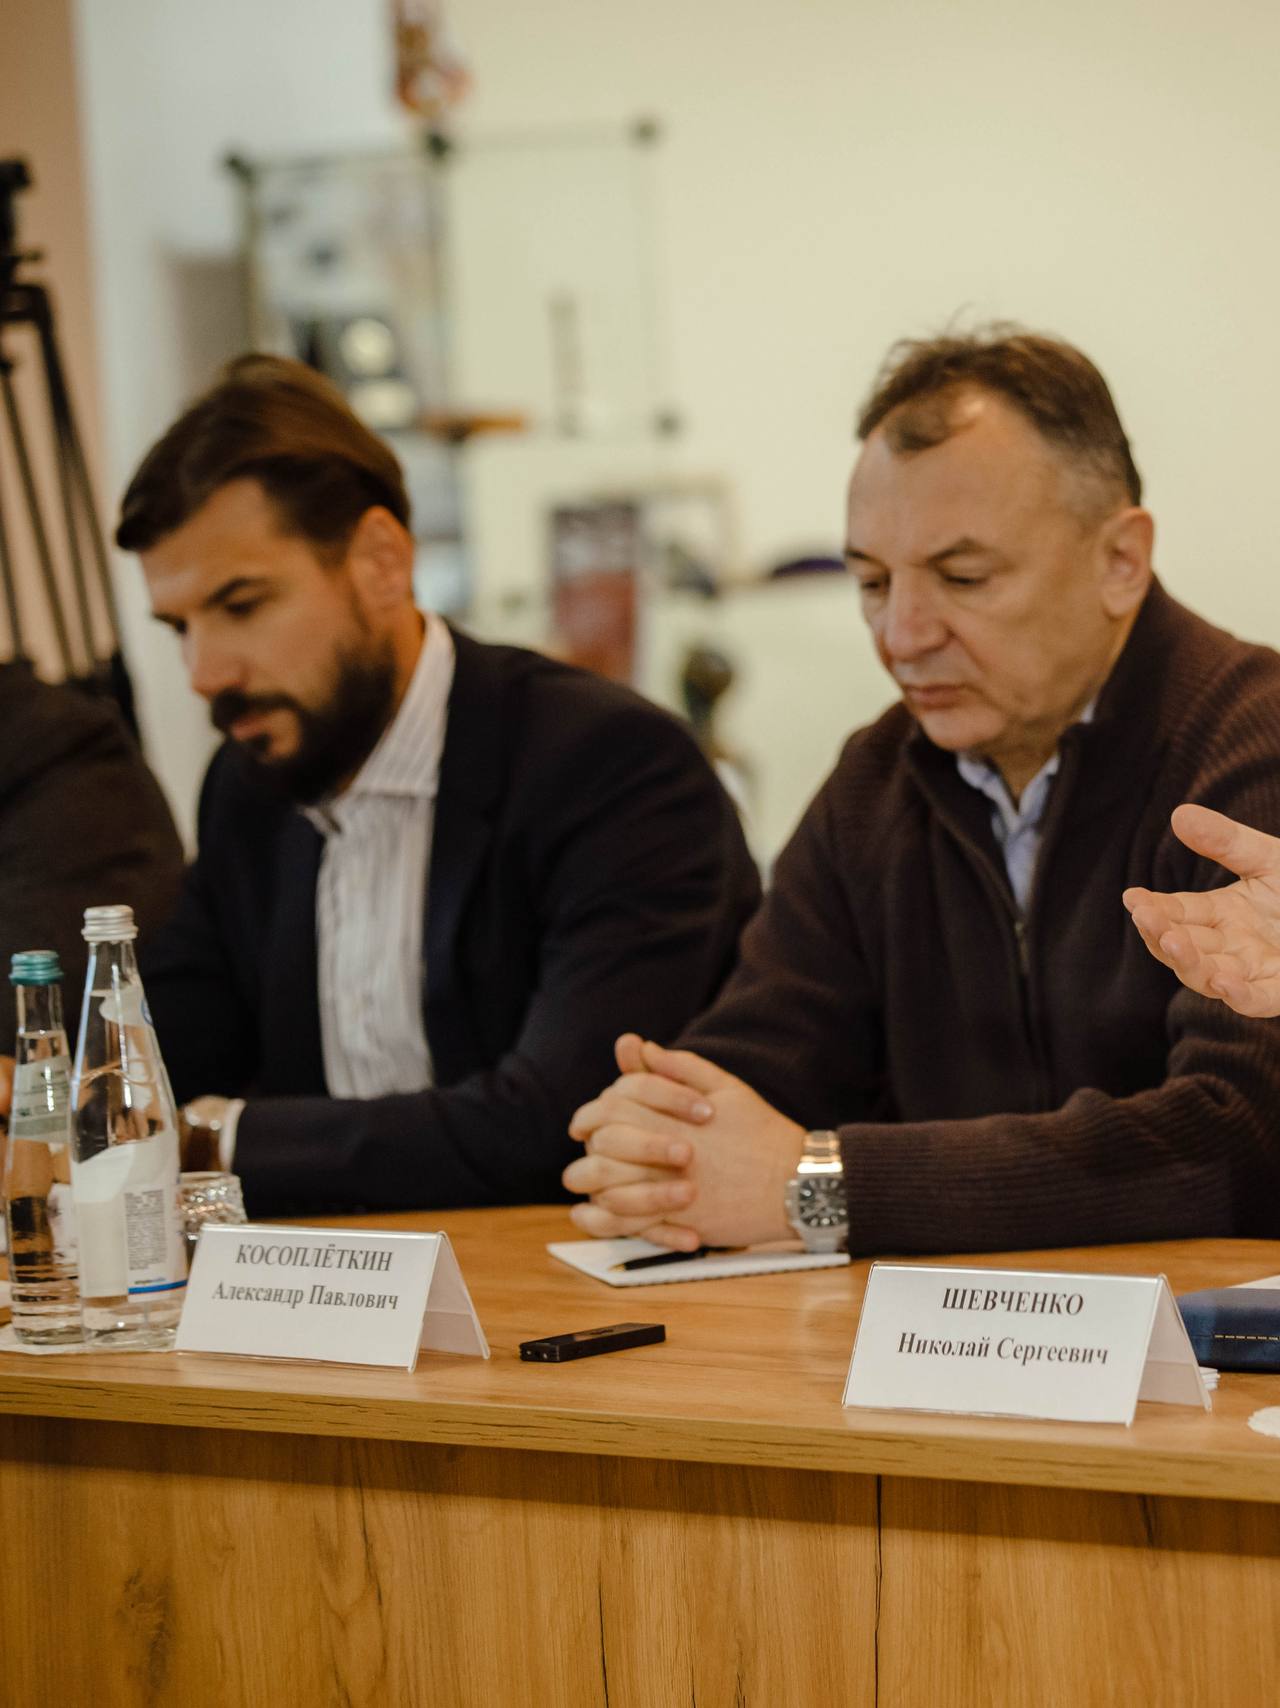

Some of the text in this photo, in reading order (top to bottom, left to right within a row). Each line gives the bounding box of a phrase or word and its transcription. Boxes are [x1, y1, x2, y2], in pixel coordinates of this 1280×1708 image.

[235, 1243, 392, 1272] КОСОПЛЁТКИН
[212, 1281, 399, 1310] Александр Павлович
[941, 1287, 1085, 1316] ШЕВЧЕНКО
[898, 1331, 1109, 1367] Николай Сергеевич
